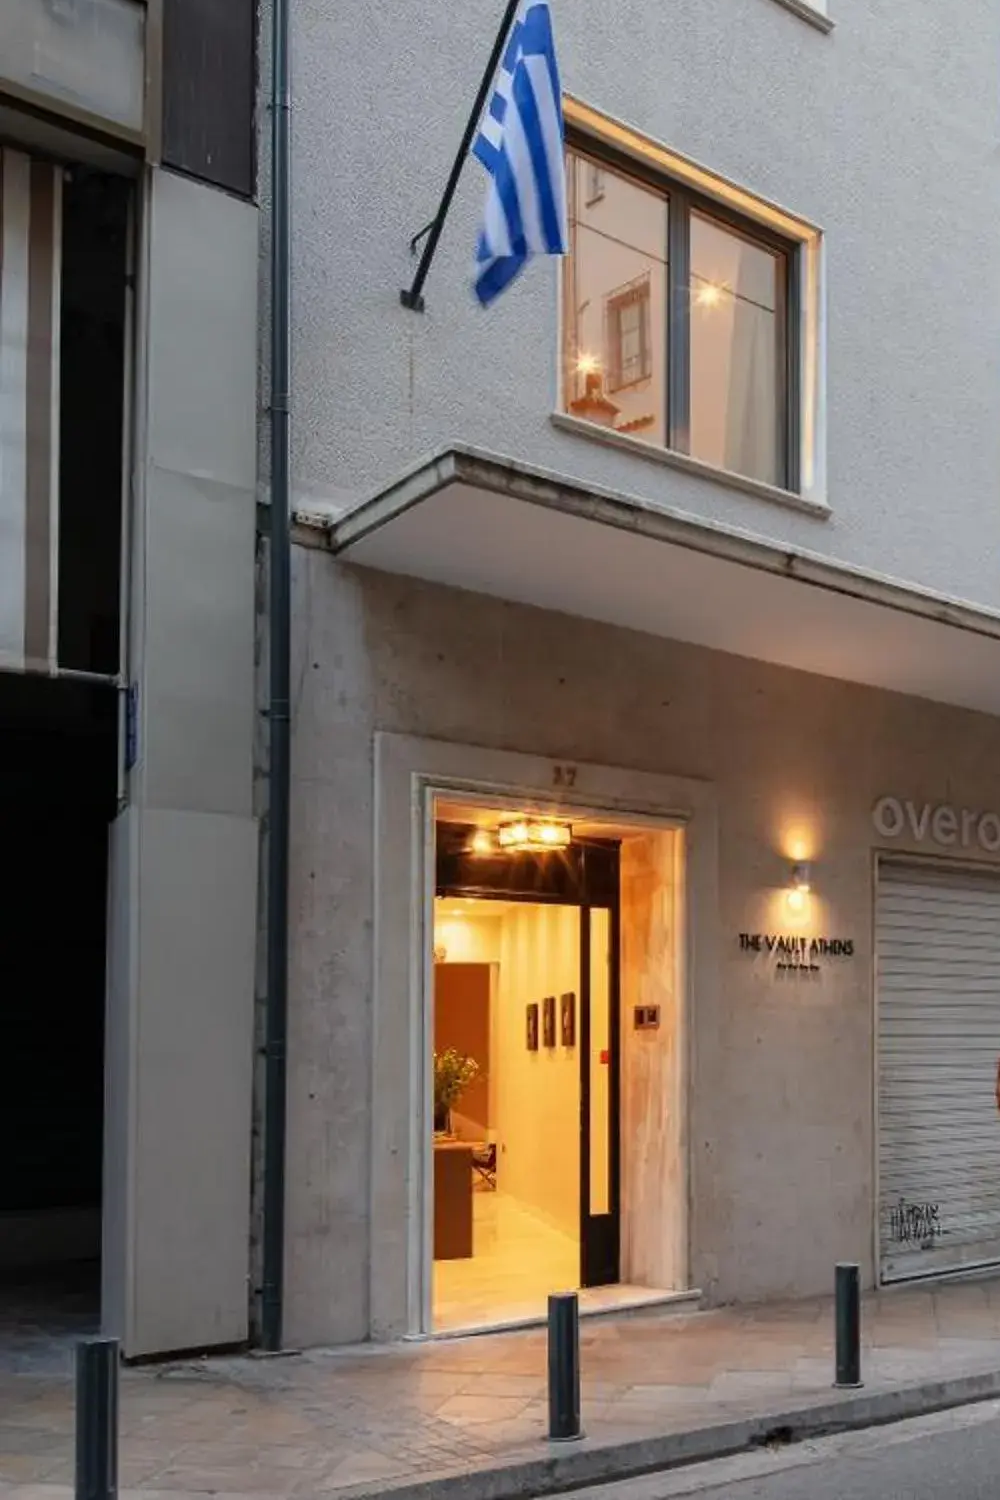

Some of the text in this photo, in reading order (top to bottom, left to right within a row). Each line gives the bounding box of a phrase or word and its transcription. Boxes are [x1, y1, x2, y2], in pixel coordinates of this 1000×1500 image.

[739, 932, 855, 958] THE VAULT ATHENS
